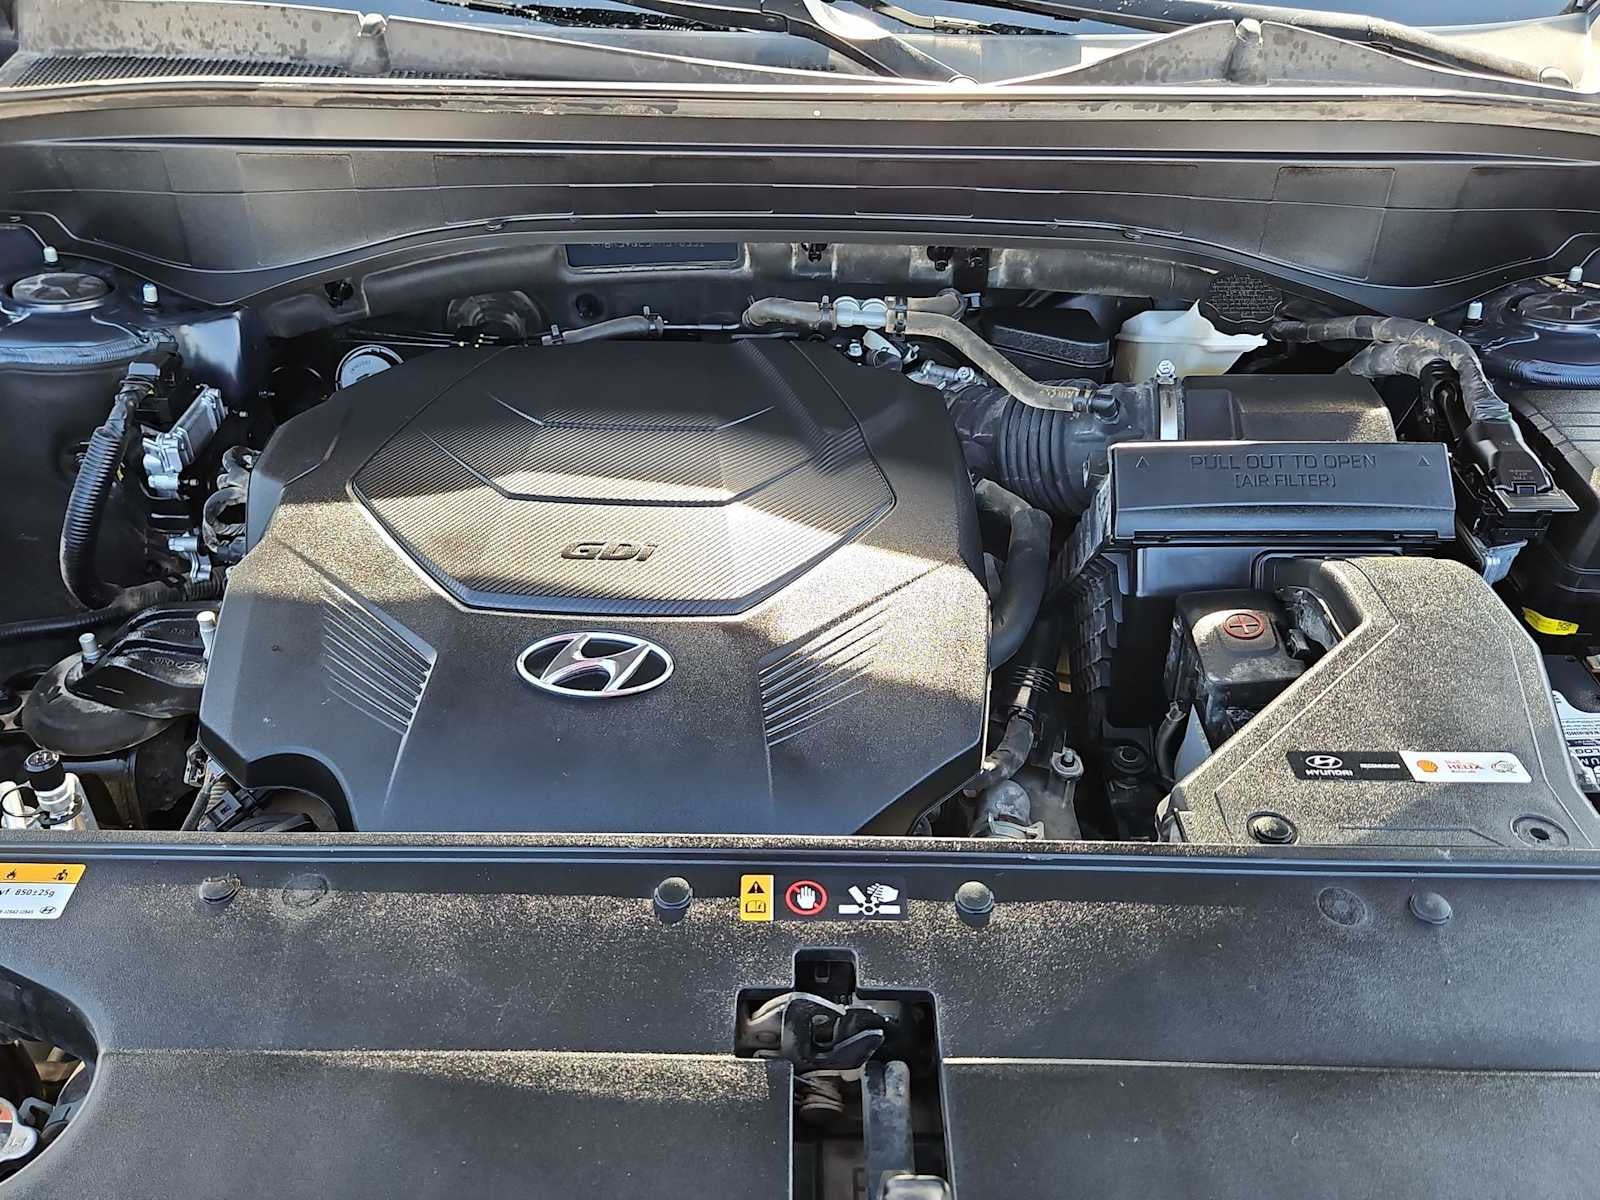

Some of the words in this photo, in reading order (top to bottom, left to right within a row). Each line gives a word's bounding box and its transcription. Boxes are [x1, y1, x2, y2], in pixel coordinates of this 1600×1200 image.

[1190, 454, 1241, 470] PULL
[1246, 454, 1285, 470] OUT
[1290, 454, 1318, 470] TO
[1323, 454, 1377, 470] OPEN
[1305, 768, 1354, 777] HYUNDAI
[15, 888, 55, 898] 850±25g
